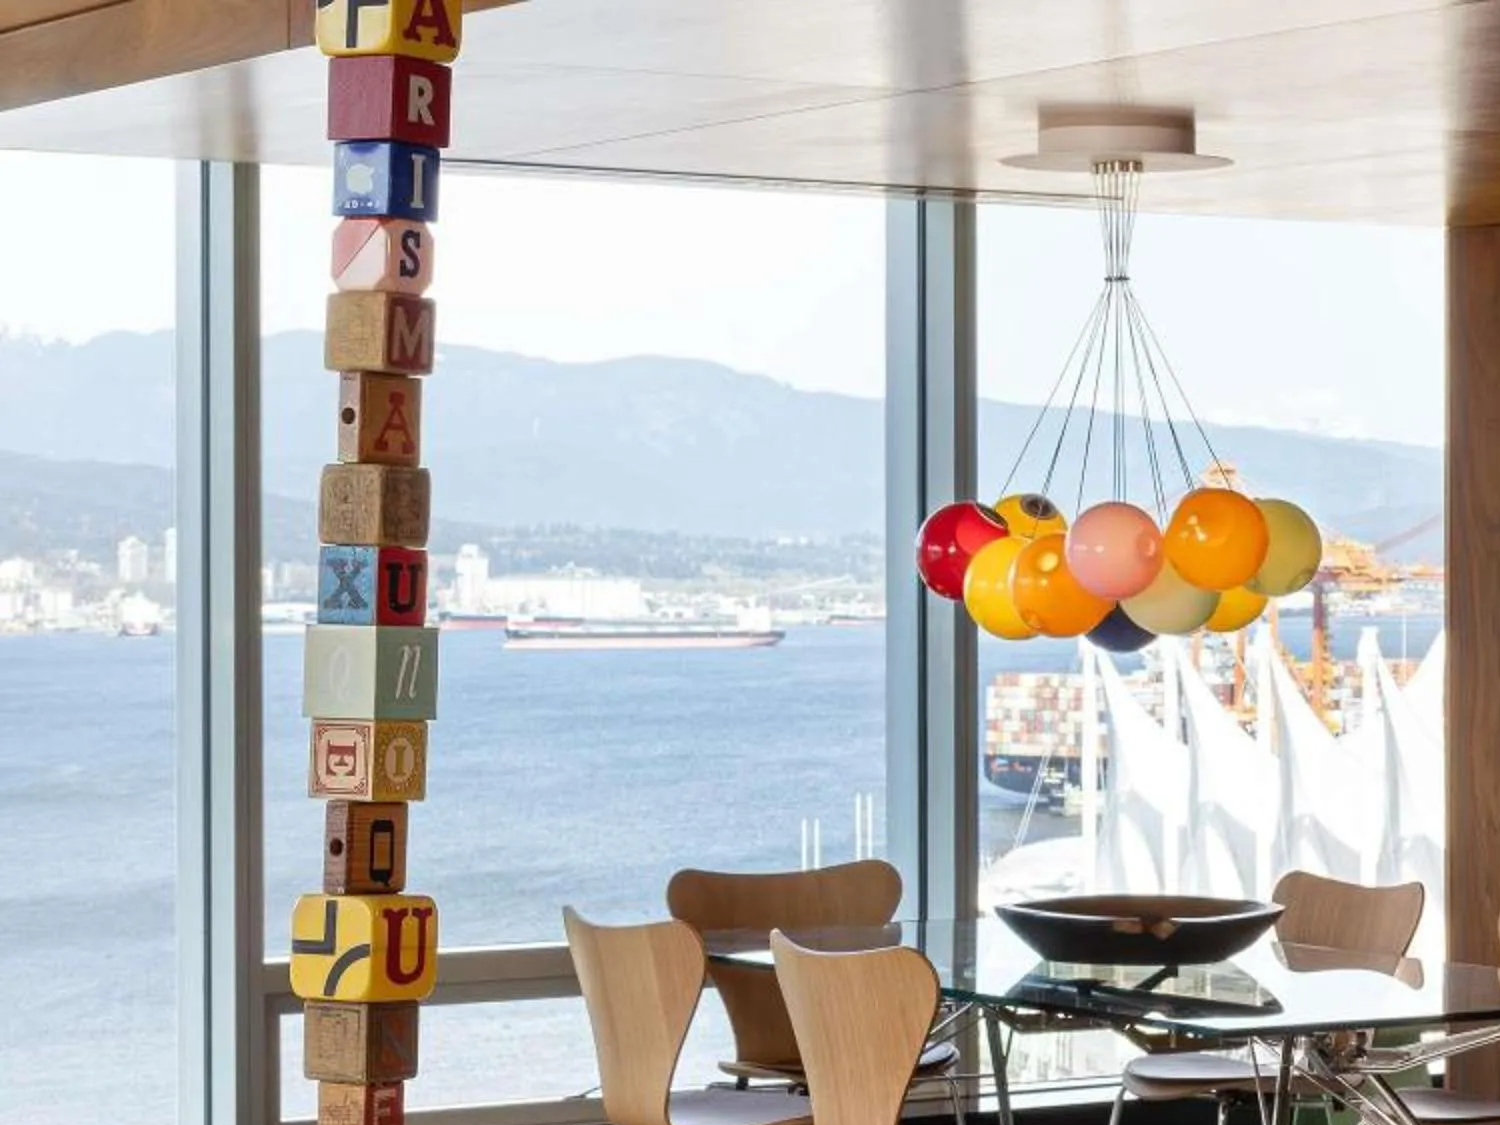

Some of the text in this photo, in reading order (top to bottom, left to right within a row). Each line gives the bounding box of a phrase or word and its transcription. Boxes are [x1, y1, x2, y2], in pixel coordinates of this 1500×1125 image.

[407, 74, 435, 126] R
[399, 229, 421, 278] S
[391, 305, 434, 365] M
[374, 391, 416, 453] A
[321, 557, 369, 611] X
[385, 562, 423, 614] U
[382, 906, 433, 986] U
